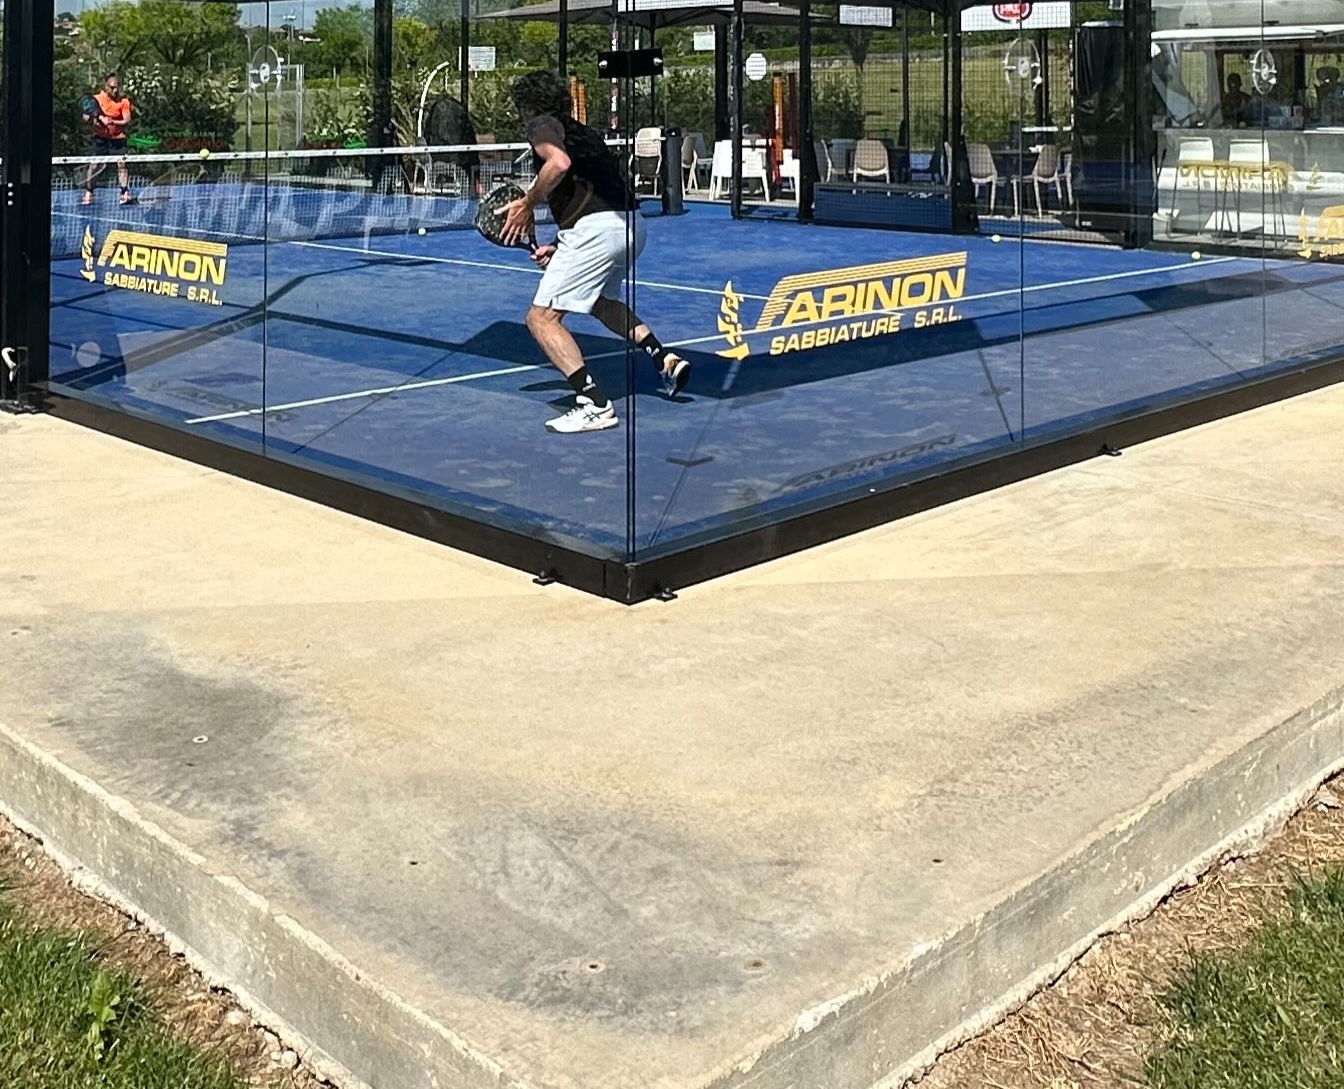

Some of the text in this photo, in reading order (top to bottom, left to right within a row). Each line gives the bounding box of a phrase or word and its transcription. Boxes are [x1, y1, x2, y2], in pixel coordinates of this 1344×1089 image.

[104, 271, 223, 306] SABBIATURE S.R.L.
[769, 305, 962, 356] SABBIATURE S.R.L.
